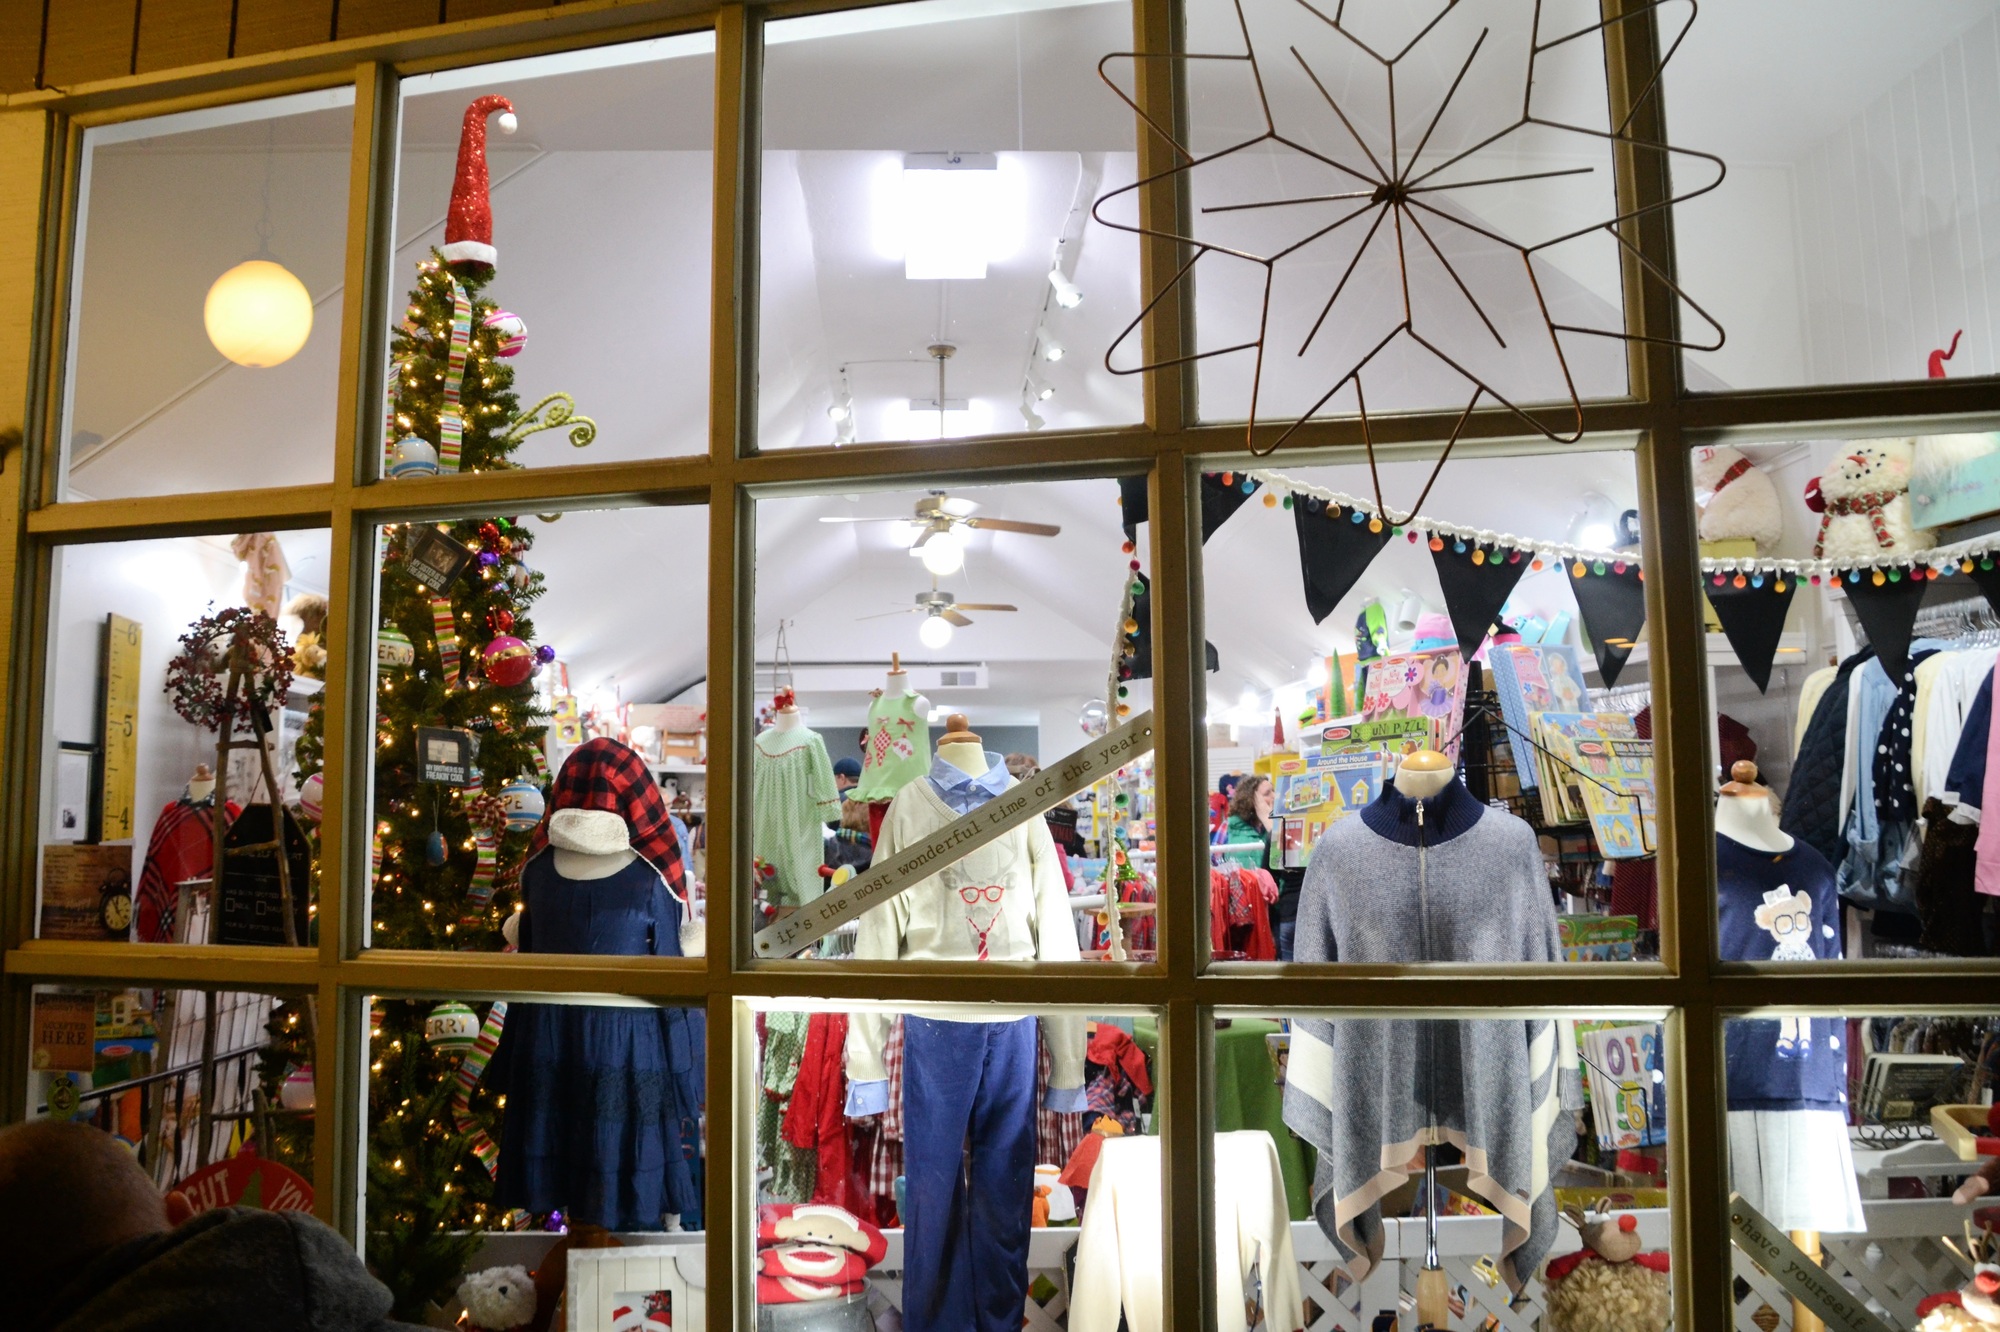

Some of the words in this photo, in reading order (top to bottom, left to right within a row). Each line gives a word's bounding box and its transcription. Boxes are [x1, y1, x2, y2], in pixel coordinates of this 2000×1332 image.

[127, 623, 138, 646] 6
[123, 714, 133, 737] 5
[1317, 757, 1338, 766] Around
[1338, 756, 1349, 764] the
[1349, 755, 1368, 763] House
[450, 772, 464, 783] COOL
[118, 806, 129, 832] 4
[776, 918, 813, 945] it's
[819, 898, 848, 920] the
[853, 873, 893, 901] most
[897, 820, 983, 876] wonderful
[989, 796, 1028, 825] time
[1034, 777, 1056, 797] of
[1062, 758, 1093, 783] the
[1098, 730, 1138, 765] year
[41, 1030, 87, 1045] HERE
[1606, 1038, 1625, 1075] 0
[1625, 1036, 1640, 1073] 1
[1641, 1034, 1655, 1071] 2
[1625, 1093, 1646, 1131] 6
[184, 1168, 231, 1215] CUT
[1740, 1218, 1781, 1259] have
[1782, 1260, 1868, 1331] yourself
